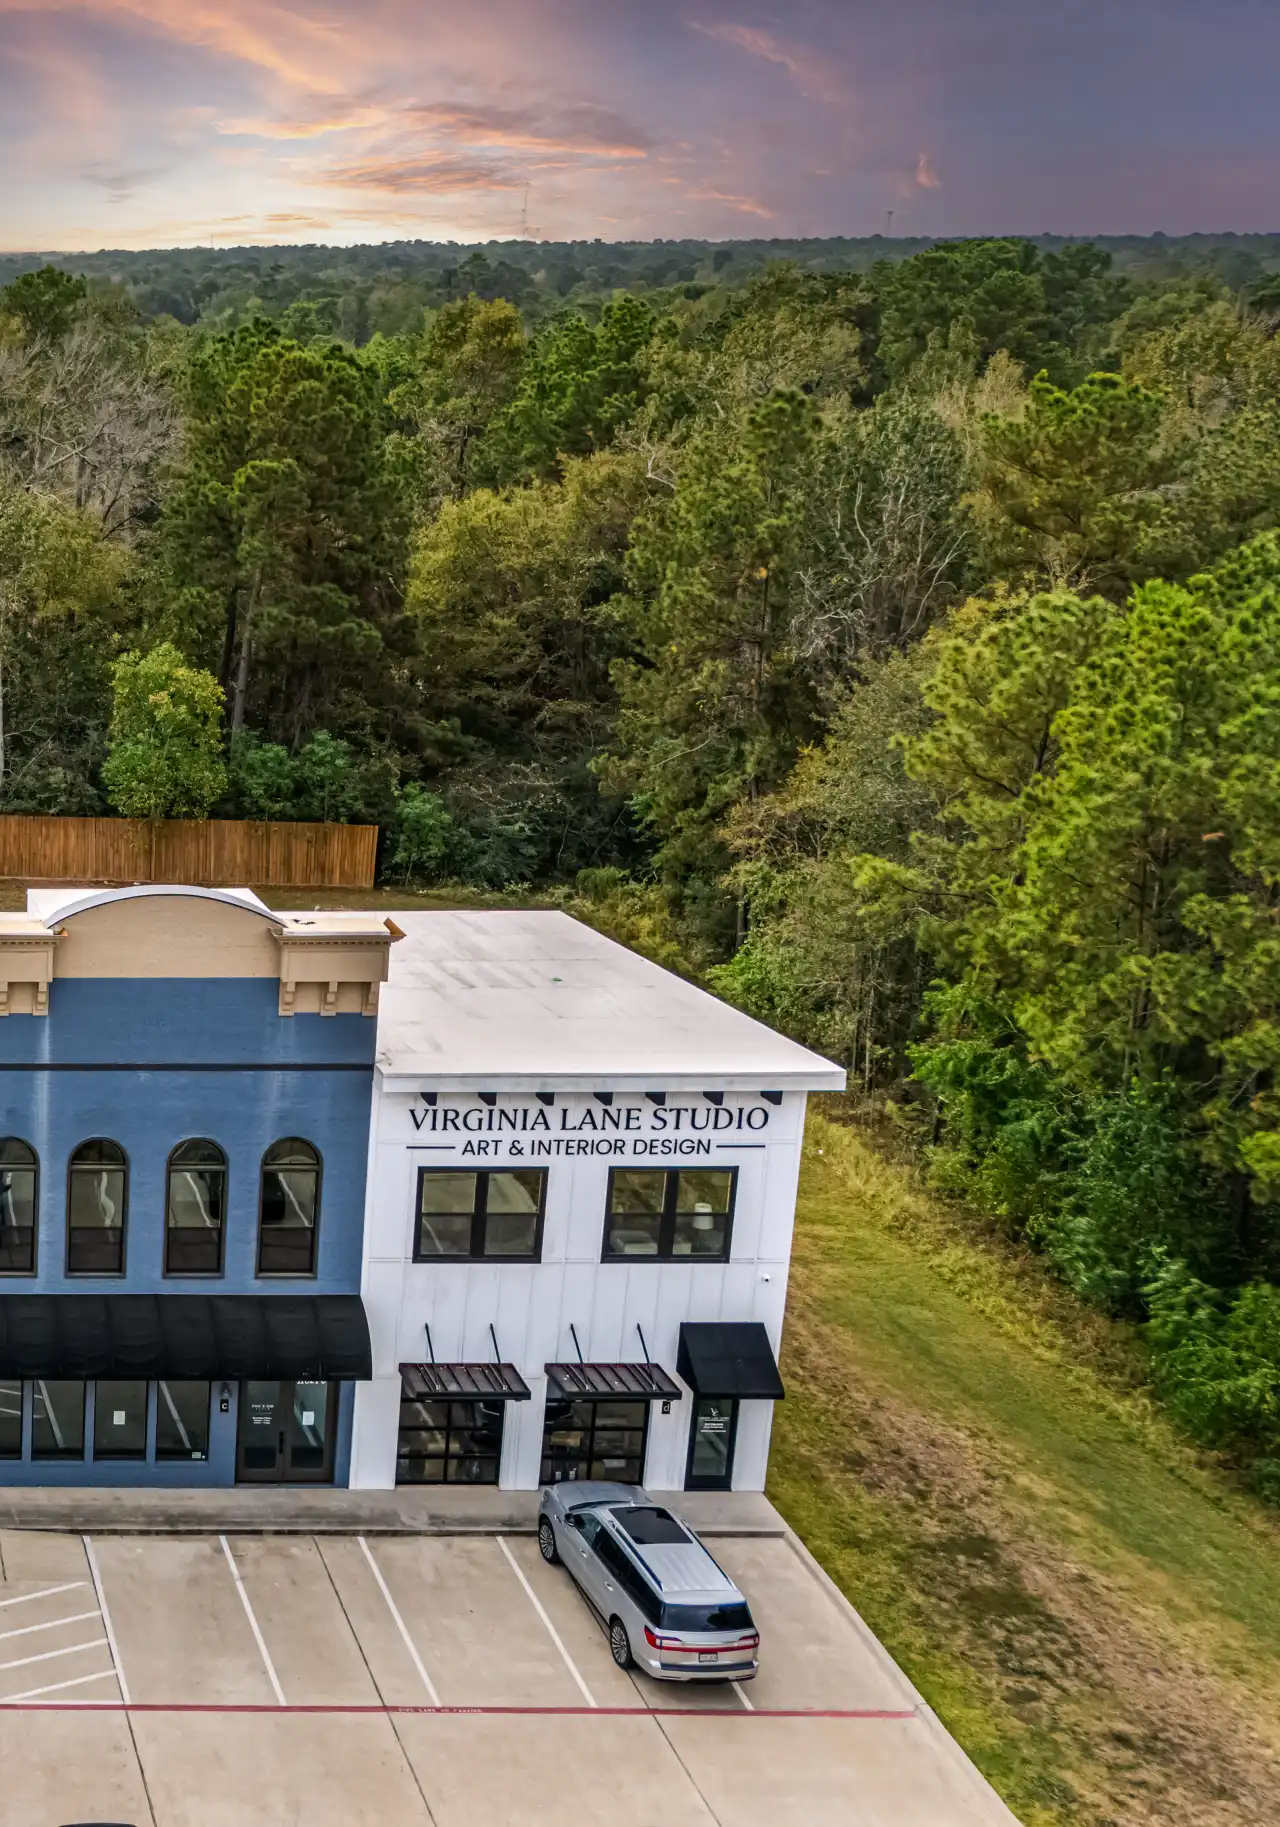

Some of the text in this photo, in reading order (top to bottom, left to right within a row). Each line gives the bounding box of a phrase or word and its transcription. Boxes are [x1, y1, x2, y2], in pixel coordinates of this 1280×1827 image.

[408, 1107, 769, 1131] VIRGINIA LANE STUDIO
[461, 1139, 711, 1156] ART & INTERIOR DESIGN
[663, 1404, 670, 1412] d
